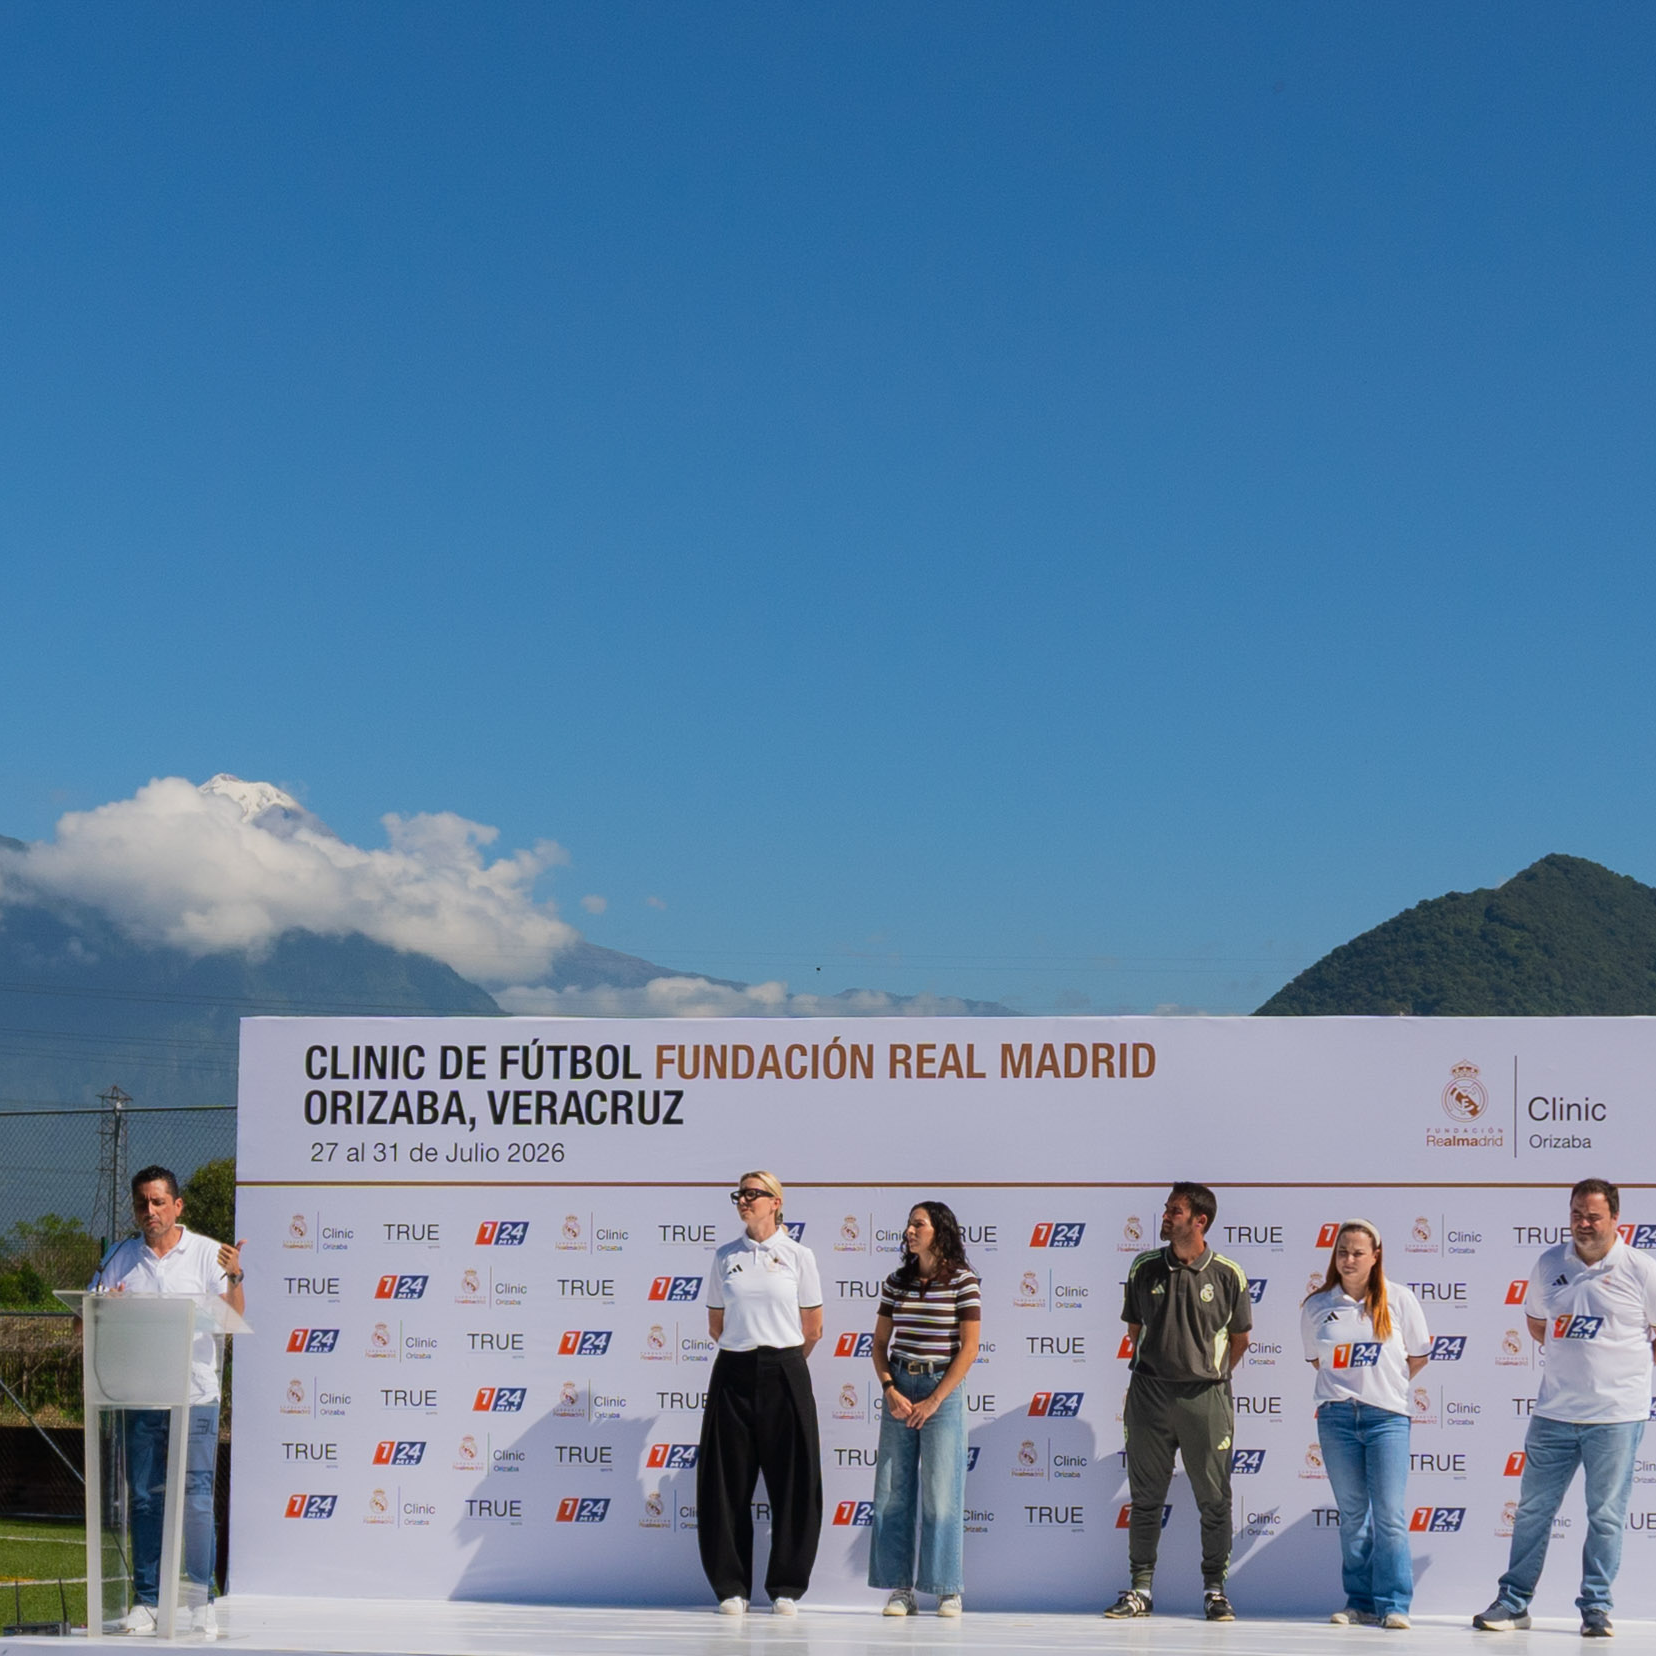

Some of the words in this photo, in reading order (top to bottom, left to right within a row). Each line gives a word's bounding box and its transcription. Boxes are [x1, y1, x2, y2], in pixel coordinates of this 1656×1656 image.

[306, 1045, 425, 1080] CLINIC
[440, 1046, 486, 1079] DE
[500, 1038, 642, 1080] FÚTBOL
[656, 1036, 873, 1080] FUNDACIÓN
[889, 1044, 986, 1079] REAL
[1001, 1043, 1155, 1078] MADRID
[305, 1090, 476, 1132] ORIZABA,
[487, 1090, 683, 1125] VERACRUZ
[1528, 1097, 1606, 1121] Clinic
[1426, 1126, 1503, 1134] FUNDACIÓN
[1427, 1135, 1503, 1147] Realmadrid
[1529, 1134, 1591, 1148] Orizaba
[311, 1142, 338, 1162] 27
[347, 1142, 364, 1162] al
[373, 1143, 397, 1162] 31
[410, 1143, 438, 1162] de
[446, 1143, 499, 1162] Julio
[508, 1143, 564, 1162] 2026
[322, 1228, 353, 1239] Clinic
[383, 1224, 439, 1240] TRUE
[596, 1229, 629, 1240] Clinic
[658, 1225, 715, 1242] TRUE
[959, 1226, 997, 1242] RUE
[1223, 1227, 1283, 1243] TRUE
[1448, 1231, 1482, 1242] Clinic
[284, 1278, 339, 1294] TRUE
[495, 1283, 527, 1294] Clinic
[557, 1280, 614, 1296] TRUE
[1055, 1286, 1088, 1297] Clinic
[1572, 1318, 1598, 1332] 24
[406, 1337, 437, 1348] Clinic
[467, 1333, 523, 1350] TRUE
[682, 1339, 714, 1351] Clinic
[1026, 1337, 1085, 1354] TRUE
[1355, 1345, 1377, 1360] 24
[320, 1393, 351, 1404] Clinic
[381, 1390, 437, 1406] TRUE
[594, 1396, 626, 1408] Clinic
[1447, 1402, 1481, 1414] Clinic
[282, 1443, 337, 1460] TRUE
[494, 1449, 525, 1461] Clinic
[555, 1446, 612, 1463] TRUE
[1054, 1455, 1087, 1467] Clinic
[1410, 1455, 1465, 1471] TRUE
[404, 1503, 435, 1514] Clinic
[465, 1500, 521, 1517] TRUE
[1024, 1506, 1083, 1523] TRUE
